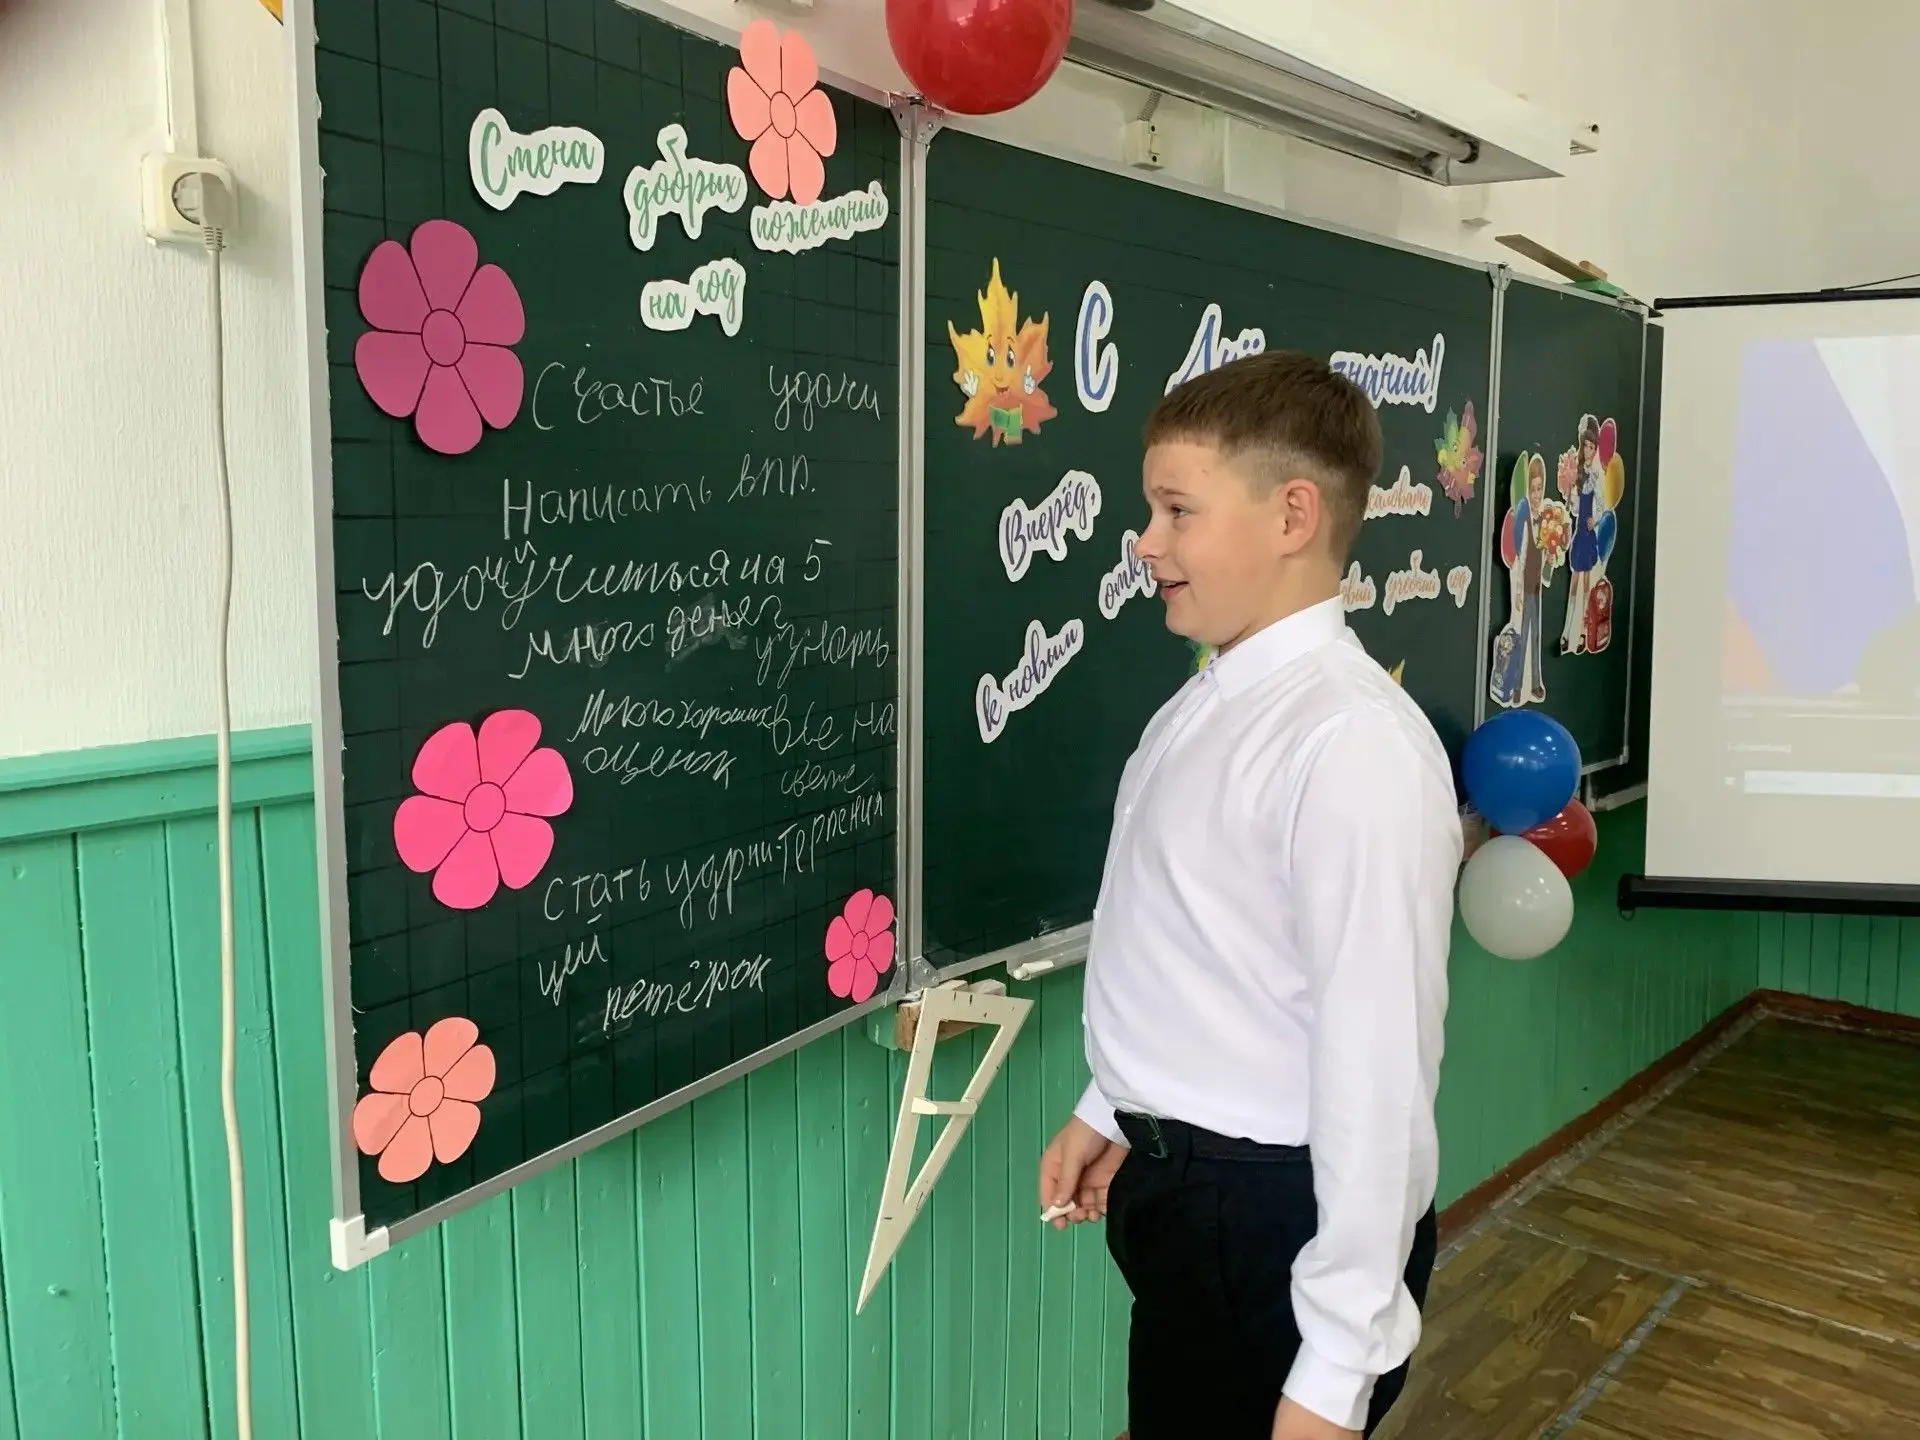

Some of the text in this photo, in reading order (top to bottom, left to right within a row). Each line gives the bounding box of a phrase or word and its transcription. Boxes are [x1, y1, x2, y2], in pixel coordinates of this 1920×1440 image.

[479, 120, 885, 243] Стена добрых пожеланий
[649, 267, 740, 324] на год
[1081, 291, 1108, 401] С
[503, 475, 713, 541] Написать
[1005, 481, 1096, 572] Вперёд,
[739, 553, 786, 585] на
[803, 538, 833, 582] 5
[850, 701, 895, 744] на
